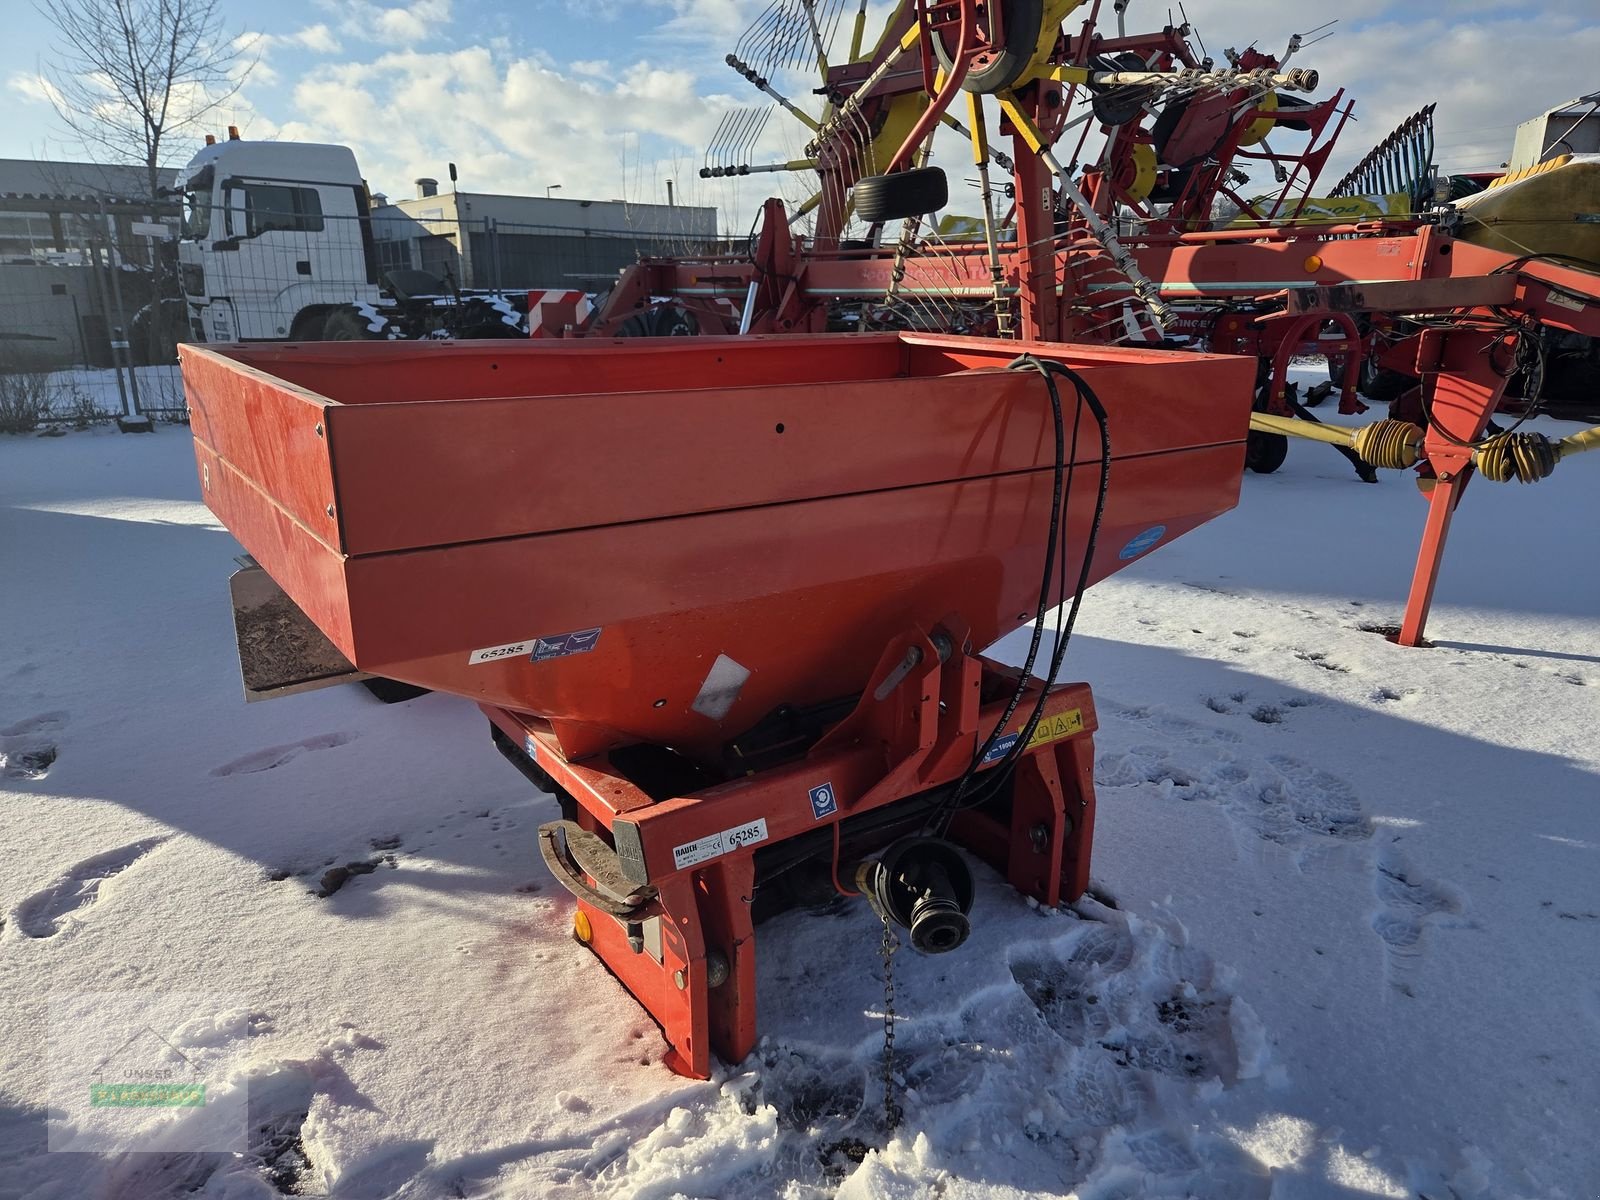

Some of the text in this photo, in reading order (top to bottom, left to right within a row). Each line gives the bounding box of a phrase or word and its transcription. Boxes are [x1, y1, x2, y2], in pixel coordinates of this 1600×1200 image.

[480, 644, 525, 660] 65285
[729, 825, 760, 846] 65285
[675, 843, 698, 858] RAUCH
